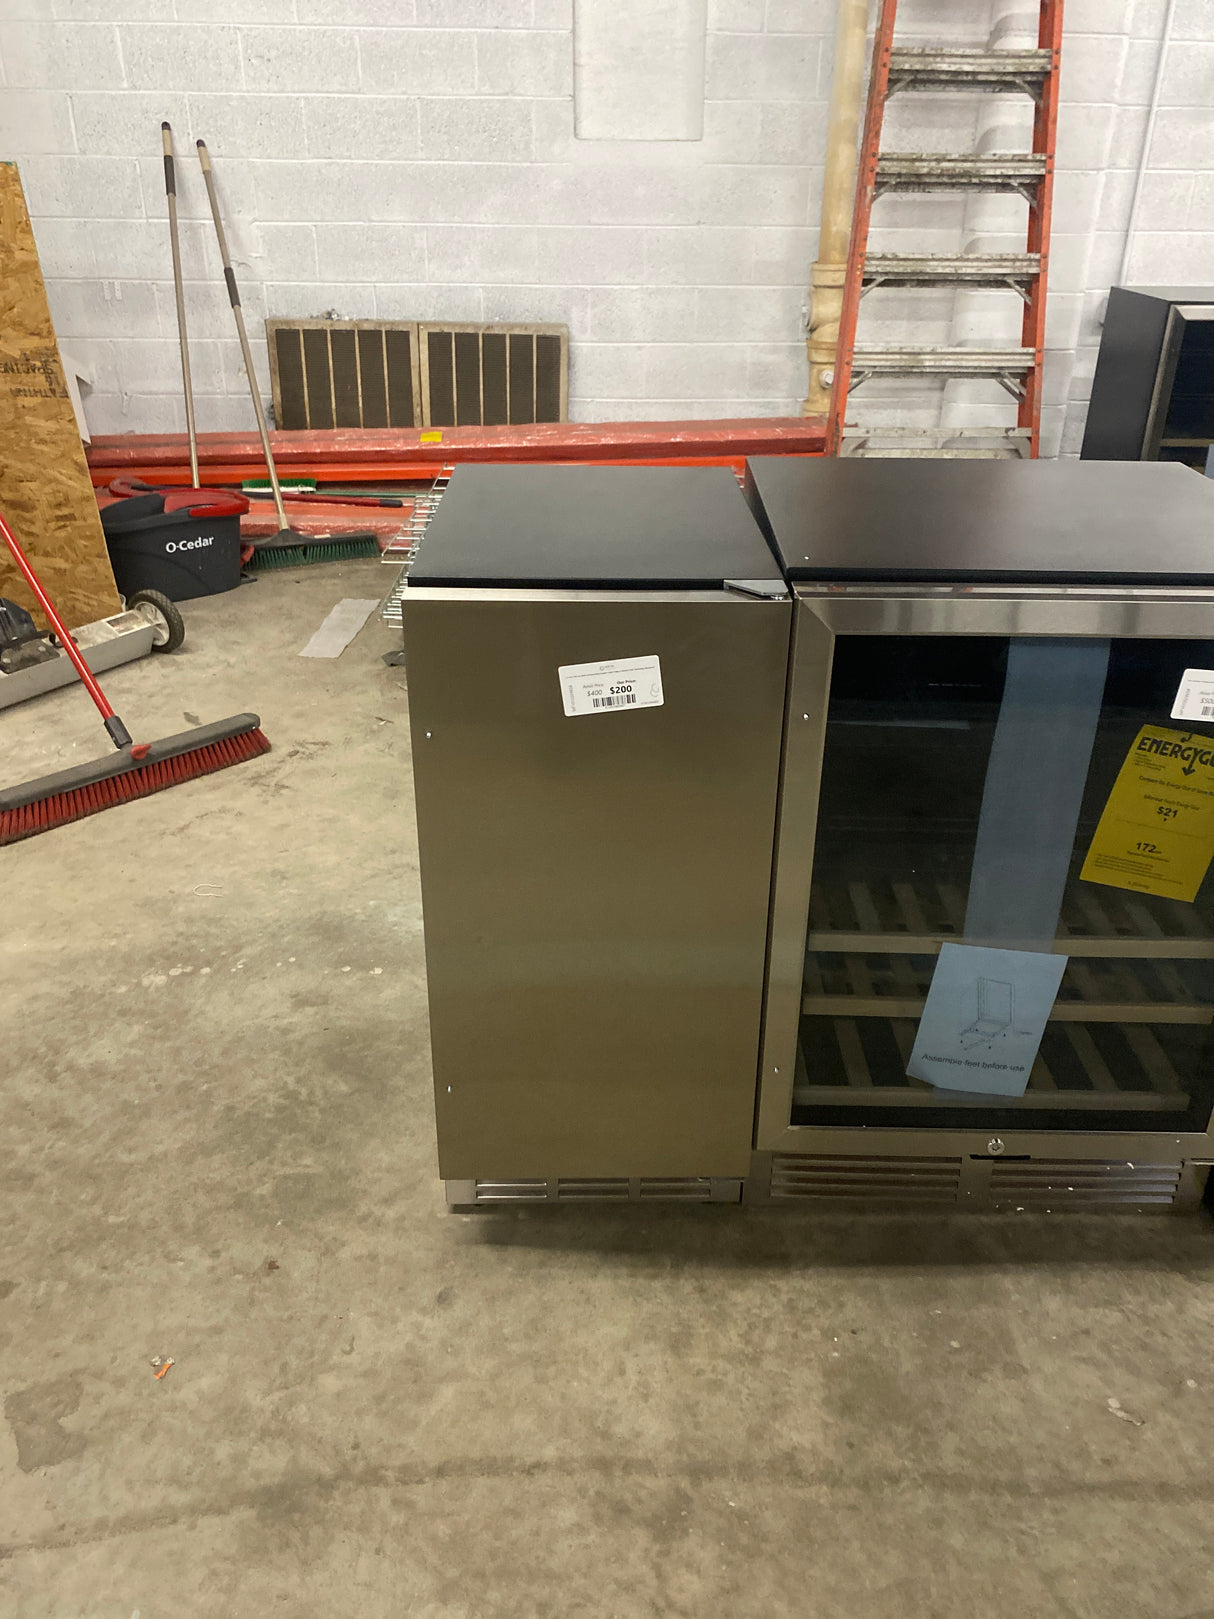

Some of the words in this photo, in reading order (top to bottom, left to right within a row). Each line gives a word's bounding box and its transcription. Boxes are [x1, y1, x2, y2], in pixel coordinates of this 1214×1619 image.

[165, 536, 214, 553] O-Cedar
[587, 689, 603, 697] $400
[609, 685, 632, 695] $200
[1136, 842, 1157, 854] 172
